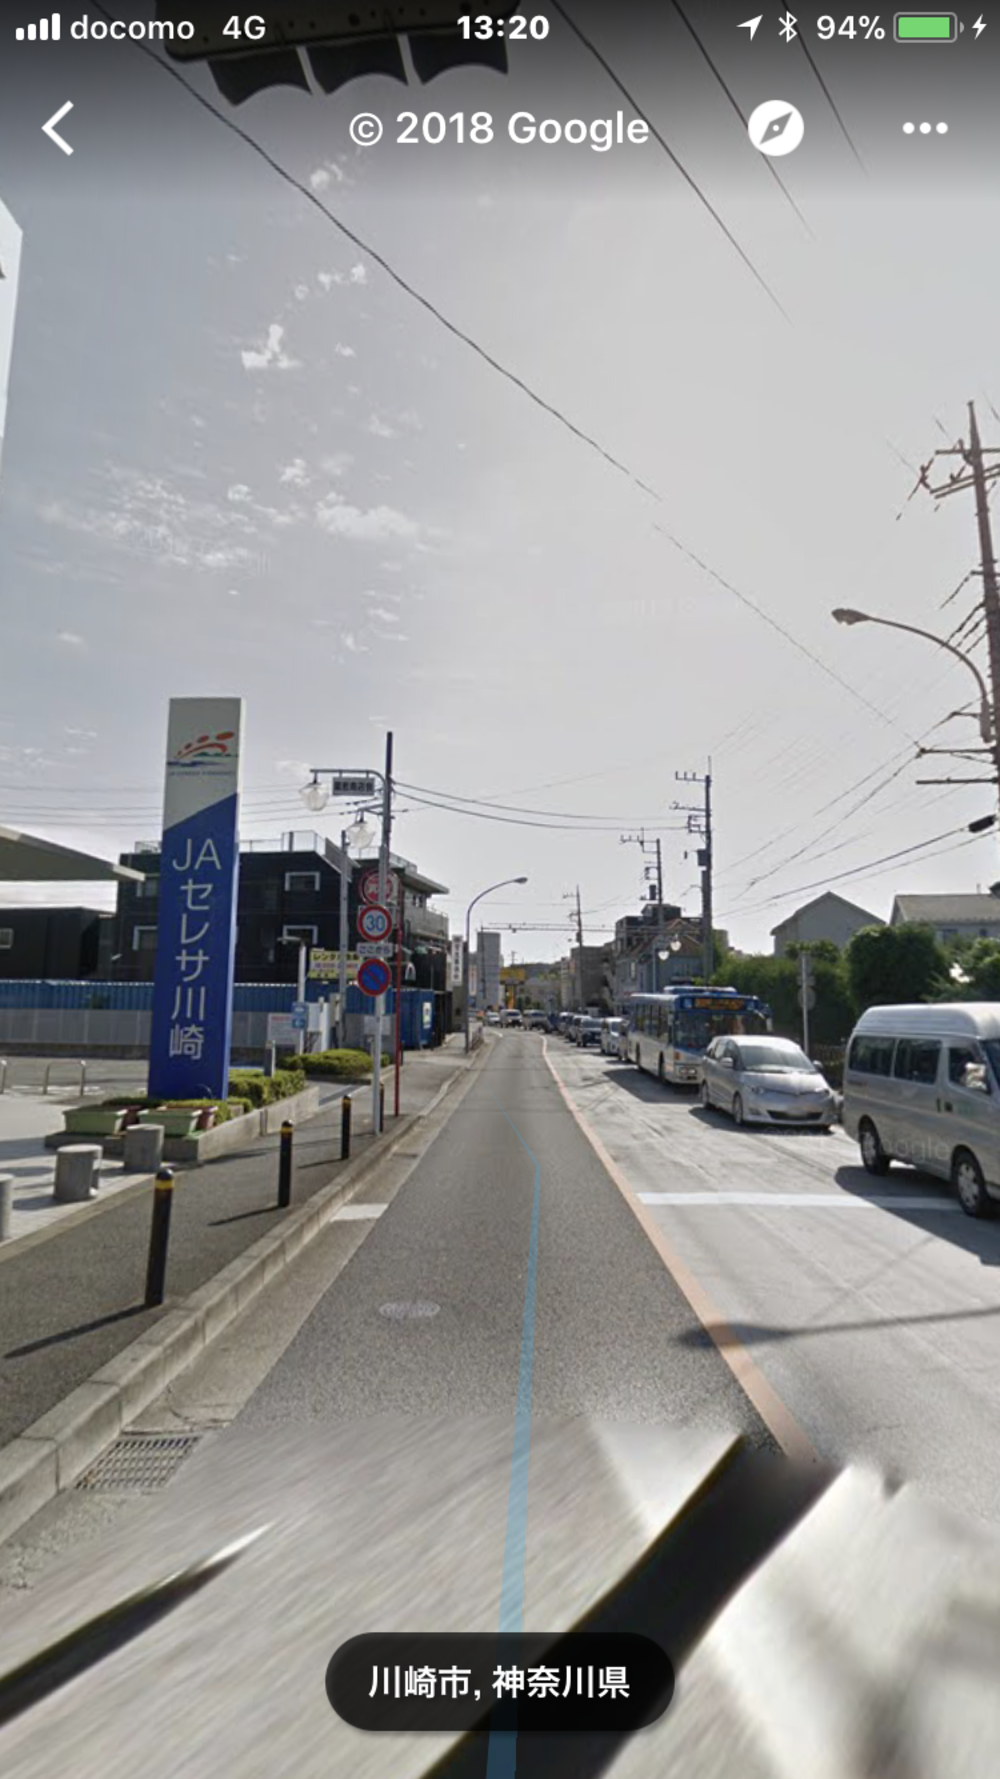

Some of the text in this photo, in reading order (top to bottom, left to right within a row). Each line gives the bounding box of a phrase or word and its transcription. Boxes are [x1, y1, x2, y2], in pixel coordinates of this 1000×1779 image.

[366, 915, 386, 932] 30
[167, 838, 222, 1060] JAセレサ川崎
[359, 945, 391, 955] ここから
